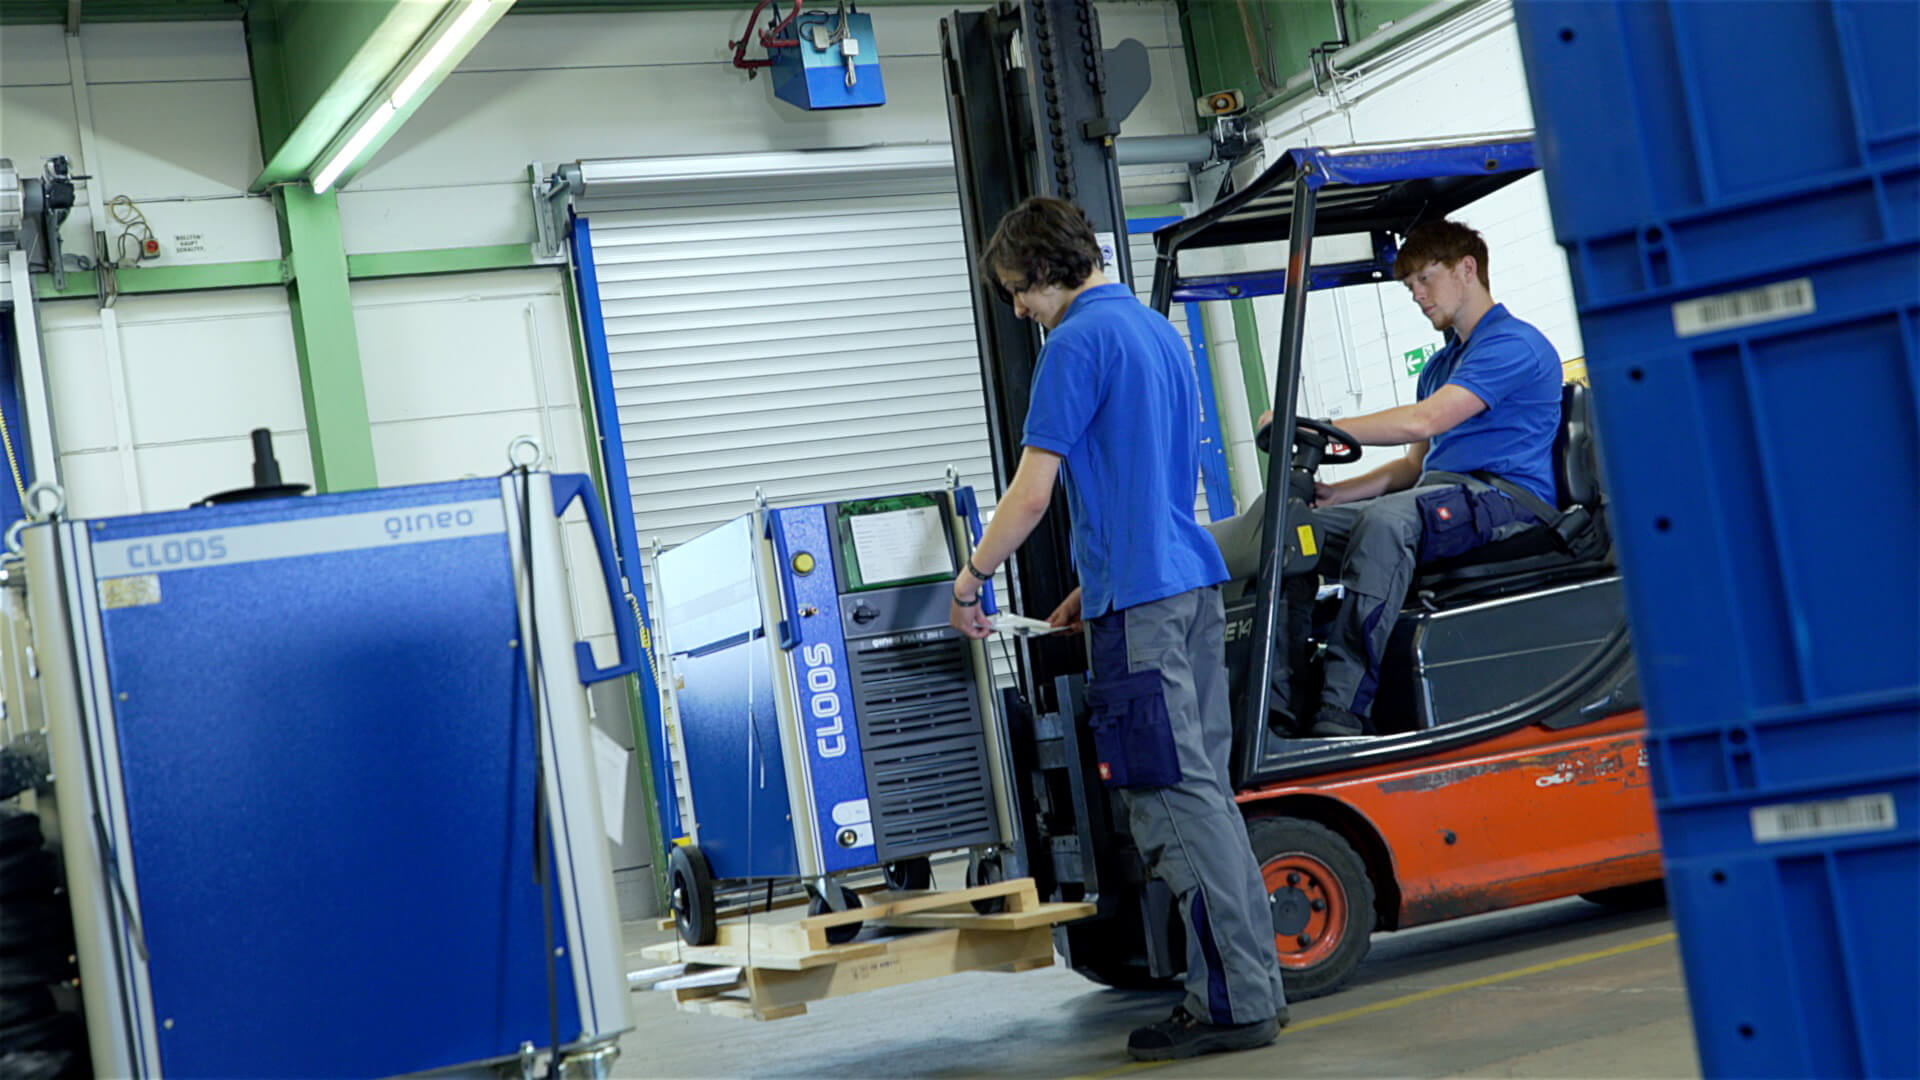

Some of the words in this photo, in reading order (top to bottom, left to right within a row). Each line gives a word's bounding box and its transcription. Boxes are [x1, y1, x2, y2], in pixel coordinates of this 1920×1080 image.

[126, 535, 227, 568] CLOOS
[1225, 617, 1253, 641] E14
[803, 642, 846, 758] CLOOS
